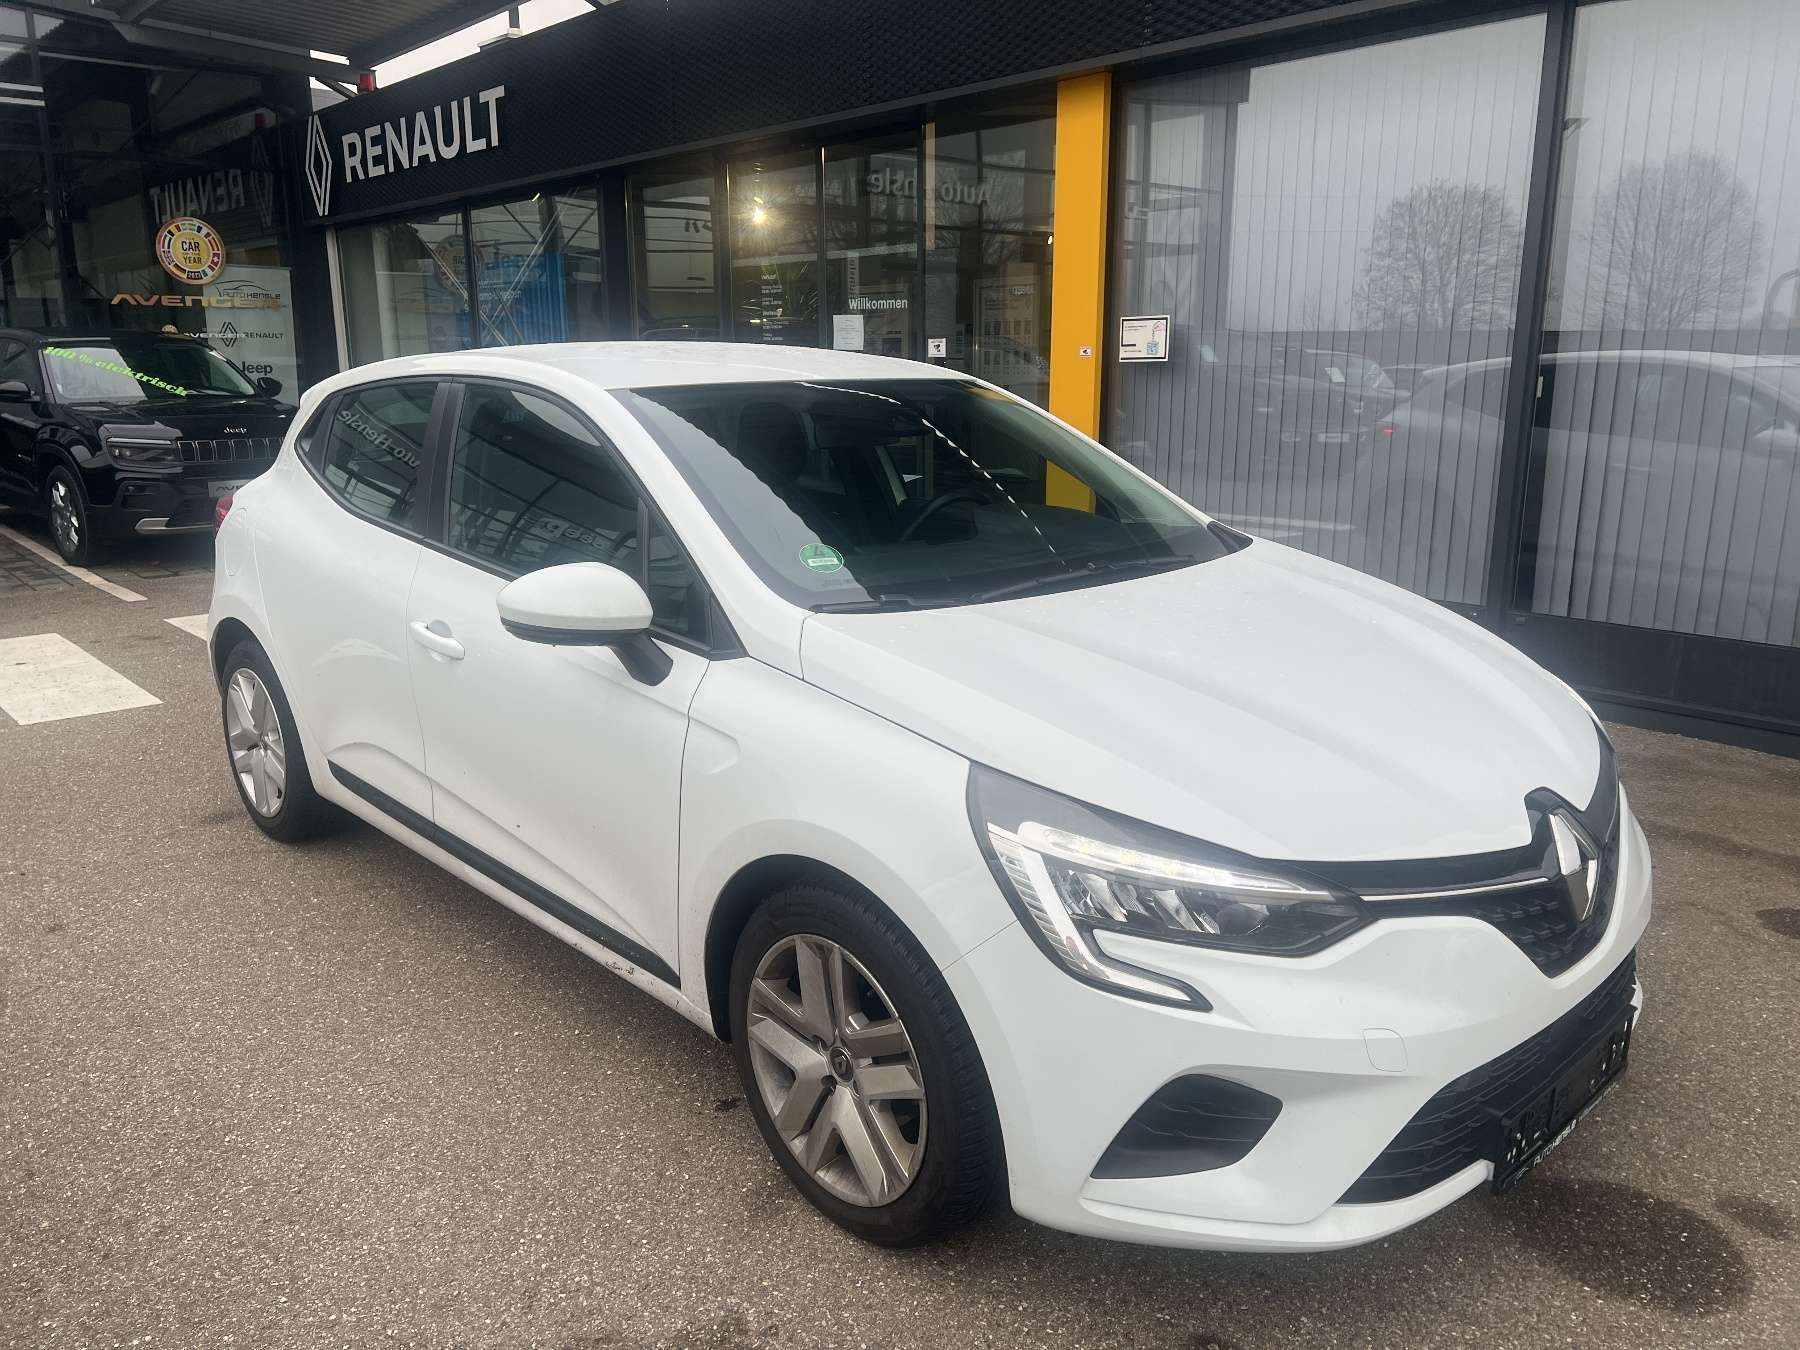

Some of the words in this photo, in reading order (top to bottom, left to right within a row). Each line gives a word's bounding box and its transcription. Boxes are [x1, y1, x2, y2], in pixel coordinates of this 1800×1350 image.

[341, 85, 505, 183] RENAULT
[181, 241, 201, 252] CAR
[183, 256, 202, 265] YEAR
[848, 297, 908, 310] Willkommen
[243, 332, 284, 340] RENAULT
[241, 361, 273, 375] Jeep
[95, 360, 188, 397] elektrisch
[224, 426, 247, 434] Jeep
